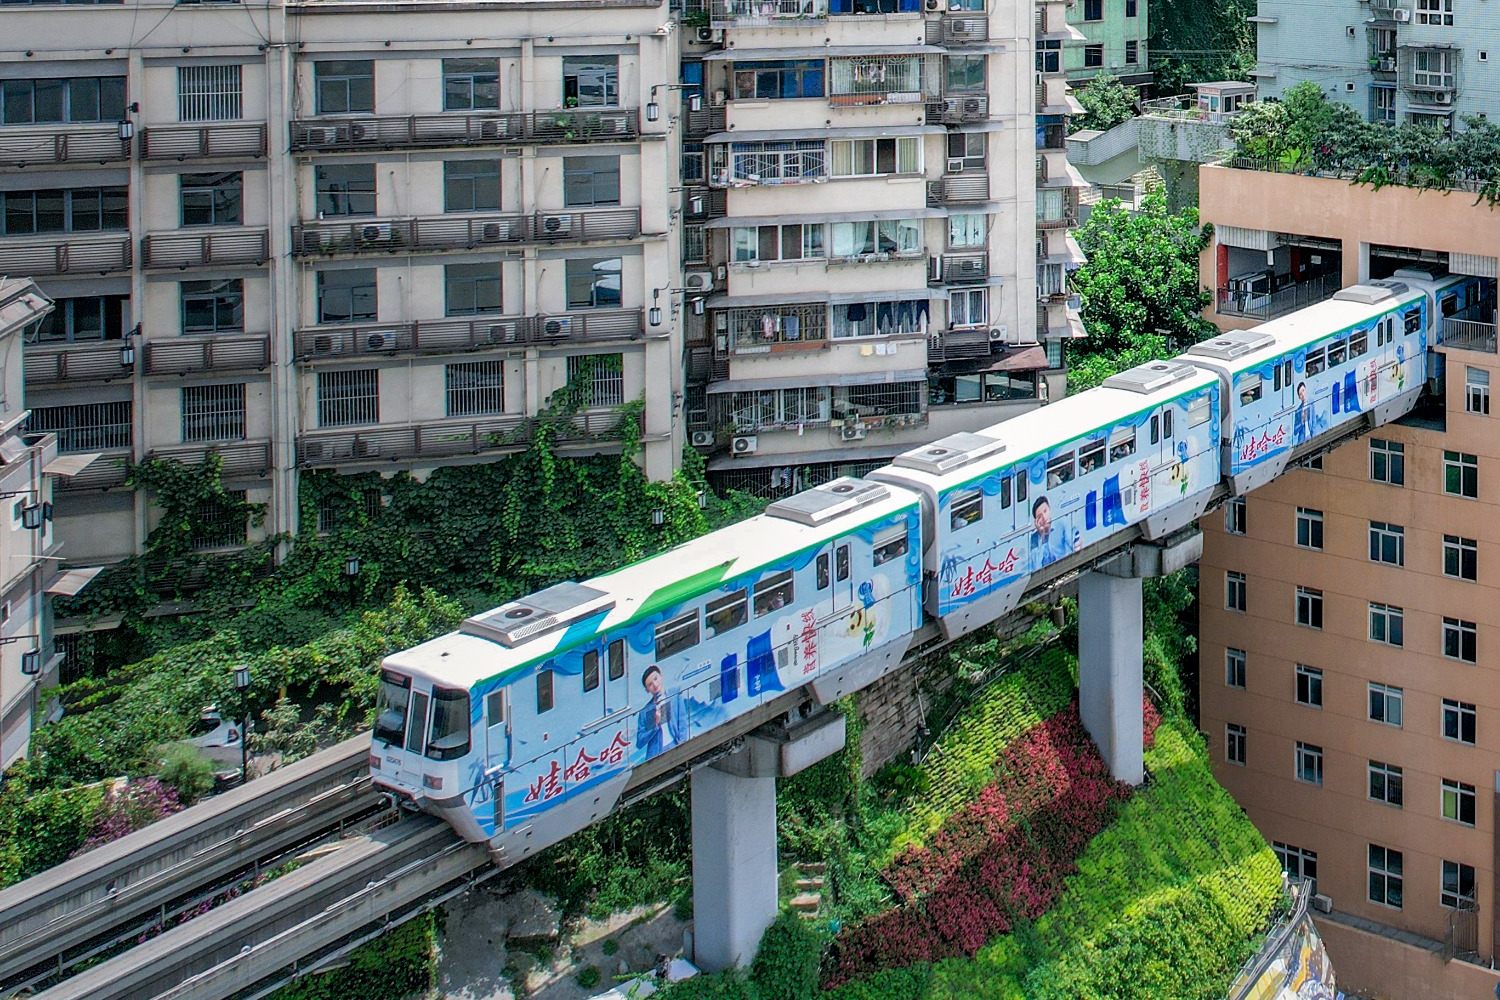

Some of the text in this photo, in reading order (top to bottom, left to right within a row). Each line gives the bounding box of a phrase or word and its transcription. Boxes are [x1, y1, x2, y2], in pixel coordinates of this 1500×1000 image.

[1240, 424, 1286, 460] 娃哈哈
[951, 547, 1020, 597] 娃哈哈
[801, 607, 817, 675] 营养快线
